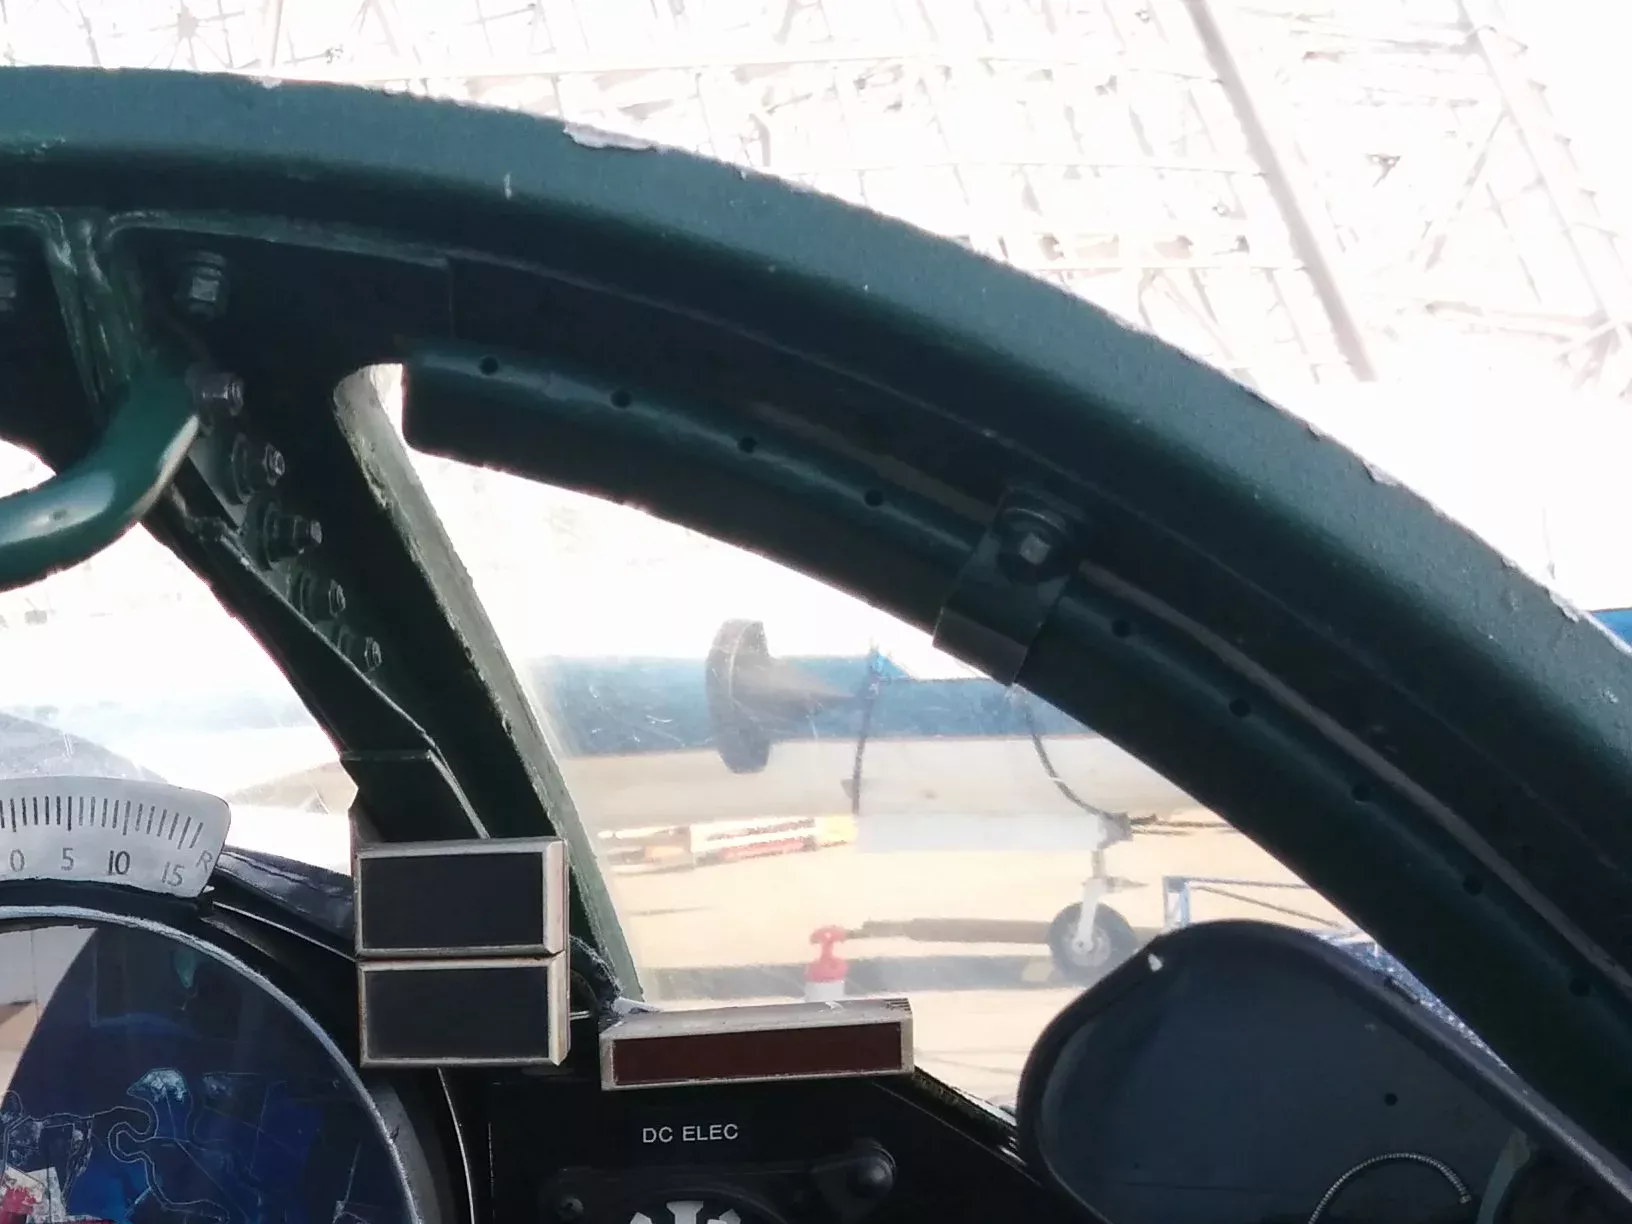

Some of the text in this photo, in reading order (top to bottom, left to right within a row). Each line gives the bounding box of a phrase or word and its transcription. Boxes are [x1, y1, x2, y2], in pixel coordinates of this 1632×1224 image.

[10, 849, 25, 871] 0
[61, 848, 74, 871] 5
[108, 850, 130, 875] 10
[161, 861, 183, 887] 15
[642, 1124, 739, 1144] DC ELEC
